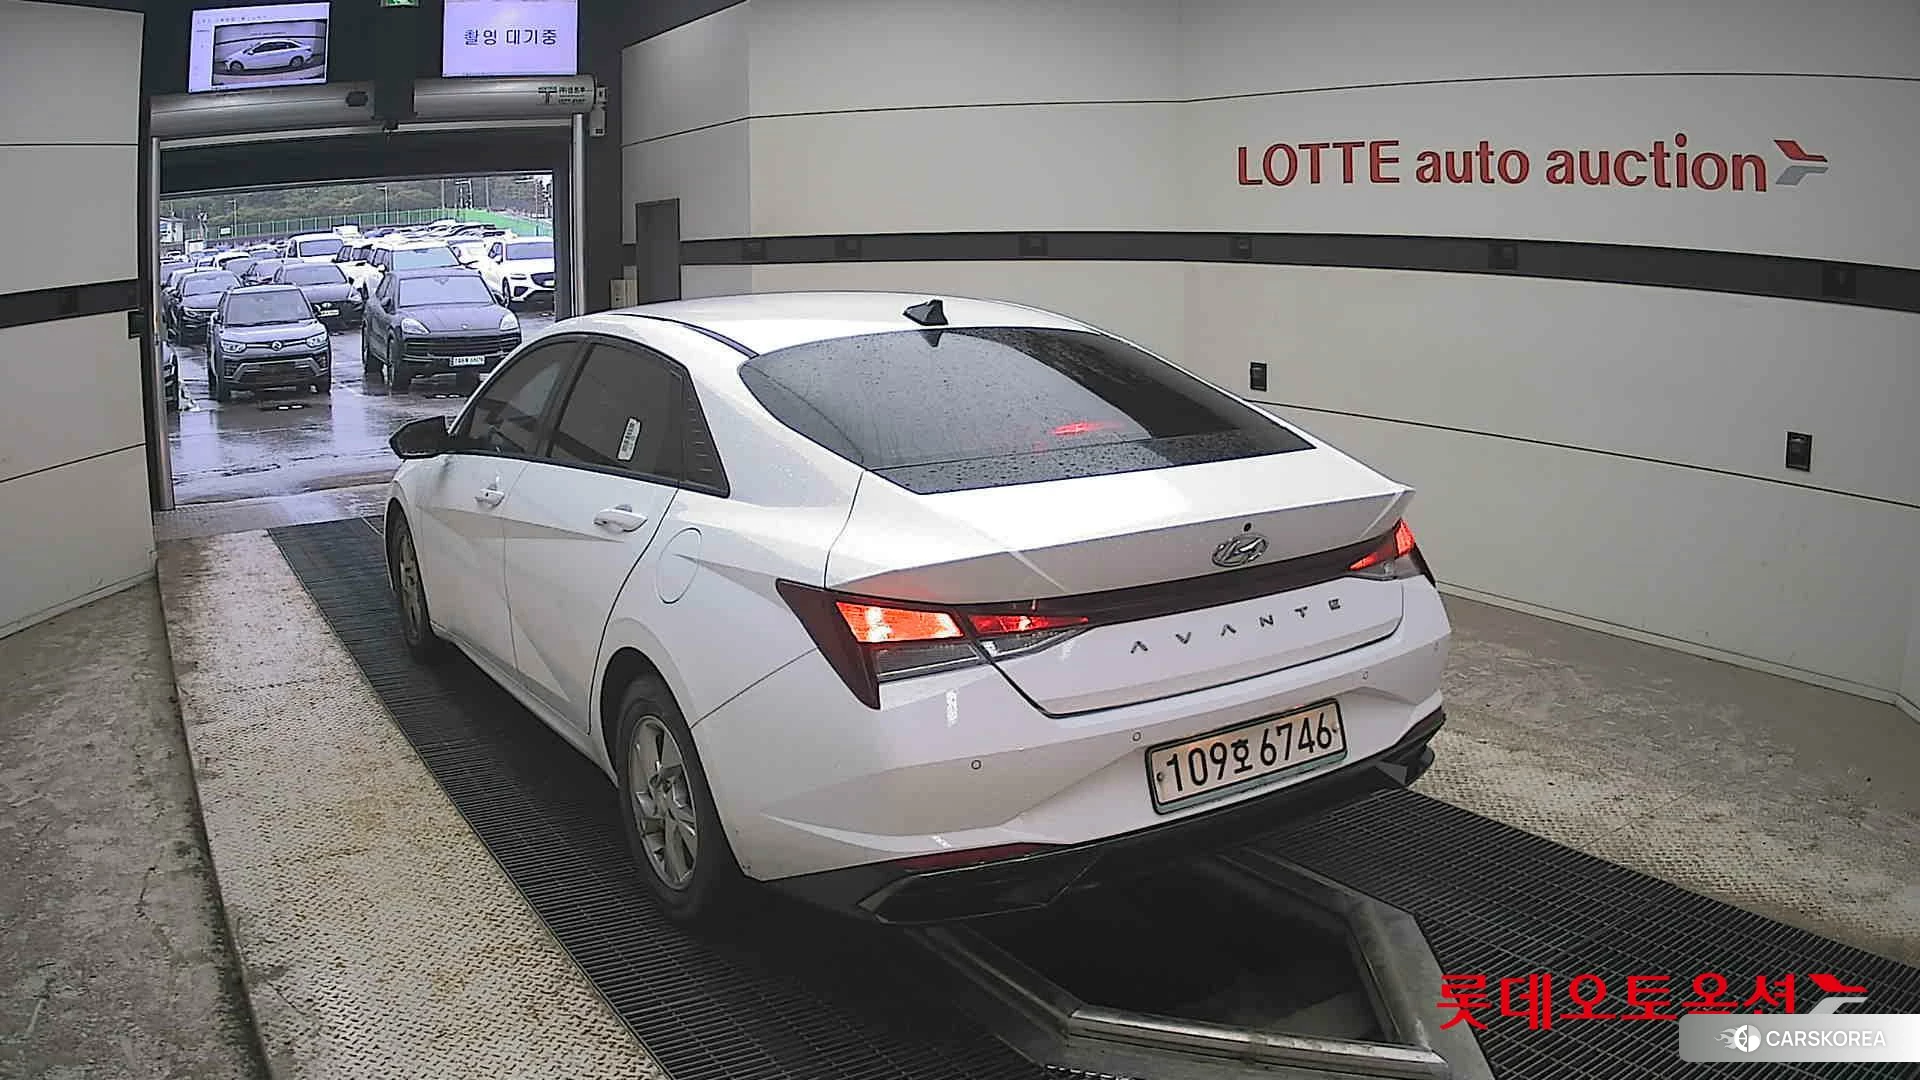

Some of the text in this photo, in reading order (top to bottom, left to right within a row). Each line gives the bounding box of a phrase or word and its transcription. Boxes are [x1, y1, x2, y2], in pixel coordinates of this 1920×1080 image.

[505, 28, 557, 46] 대기중
[1237, 132, 1768, 192] LOTTE auto auction
[1129, 597, 1342, 654] AVANTE
